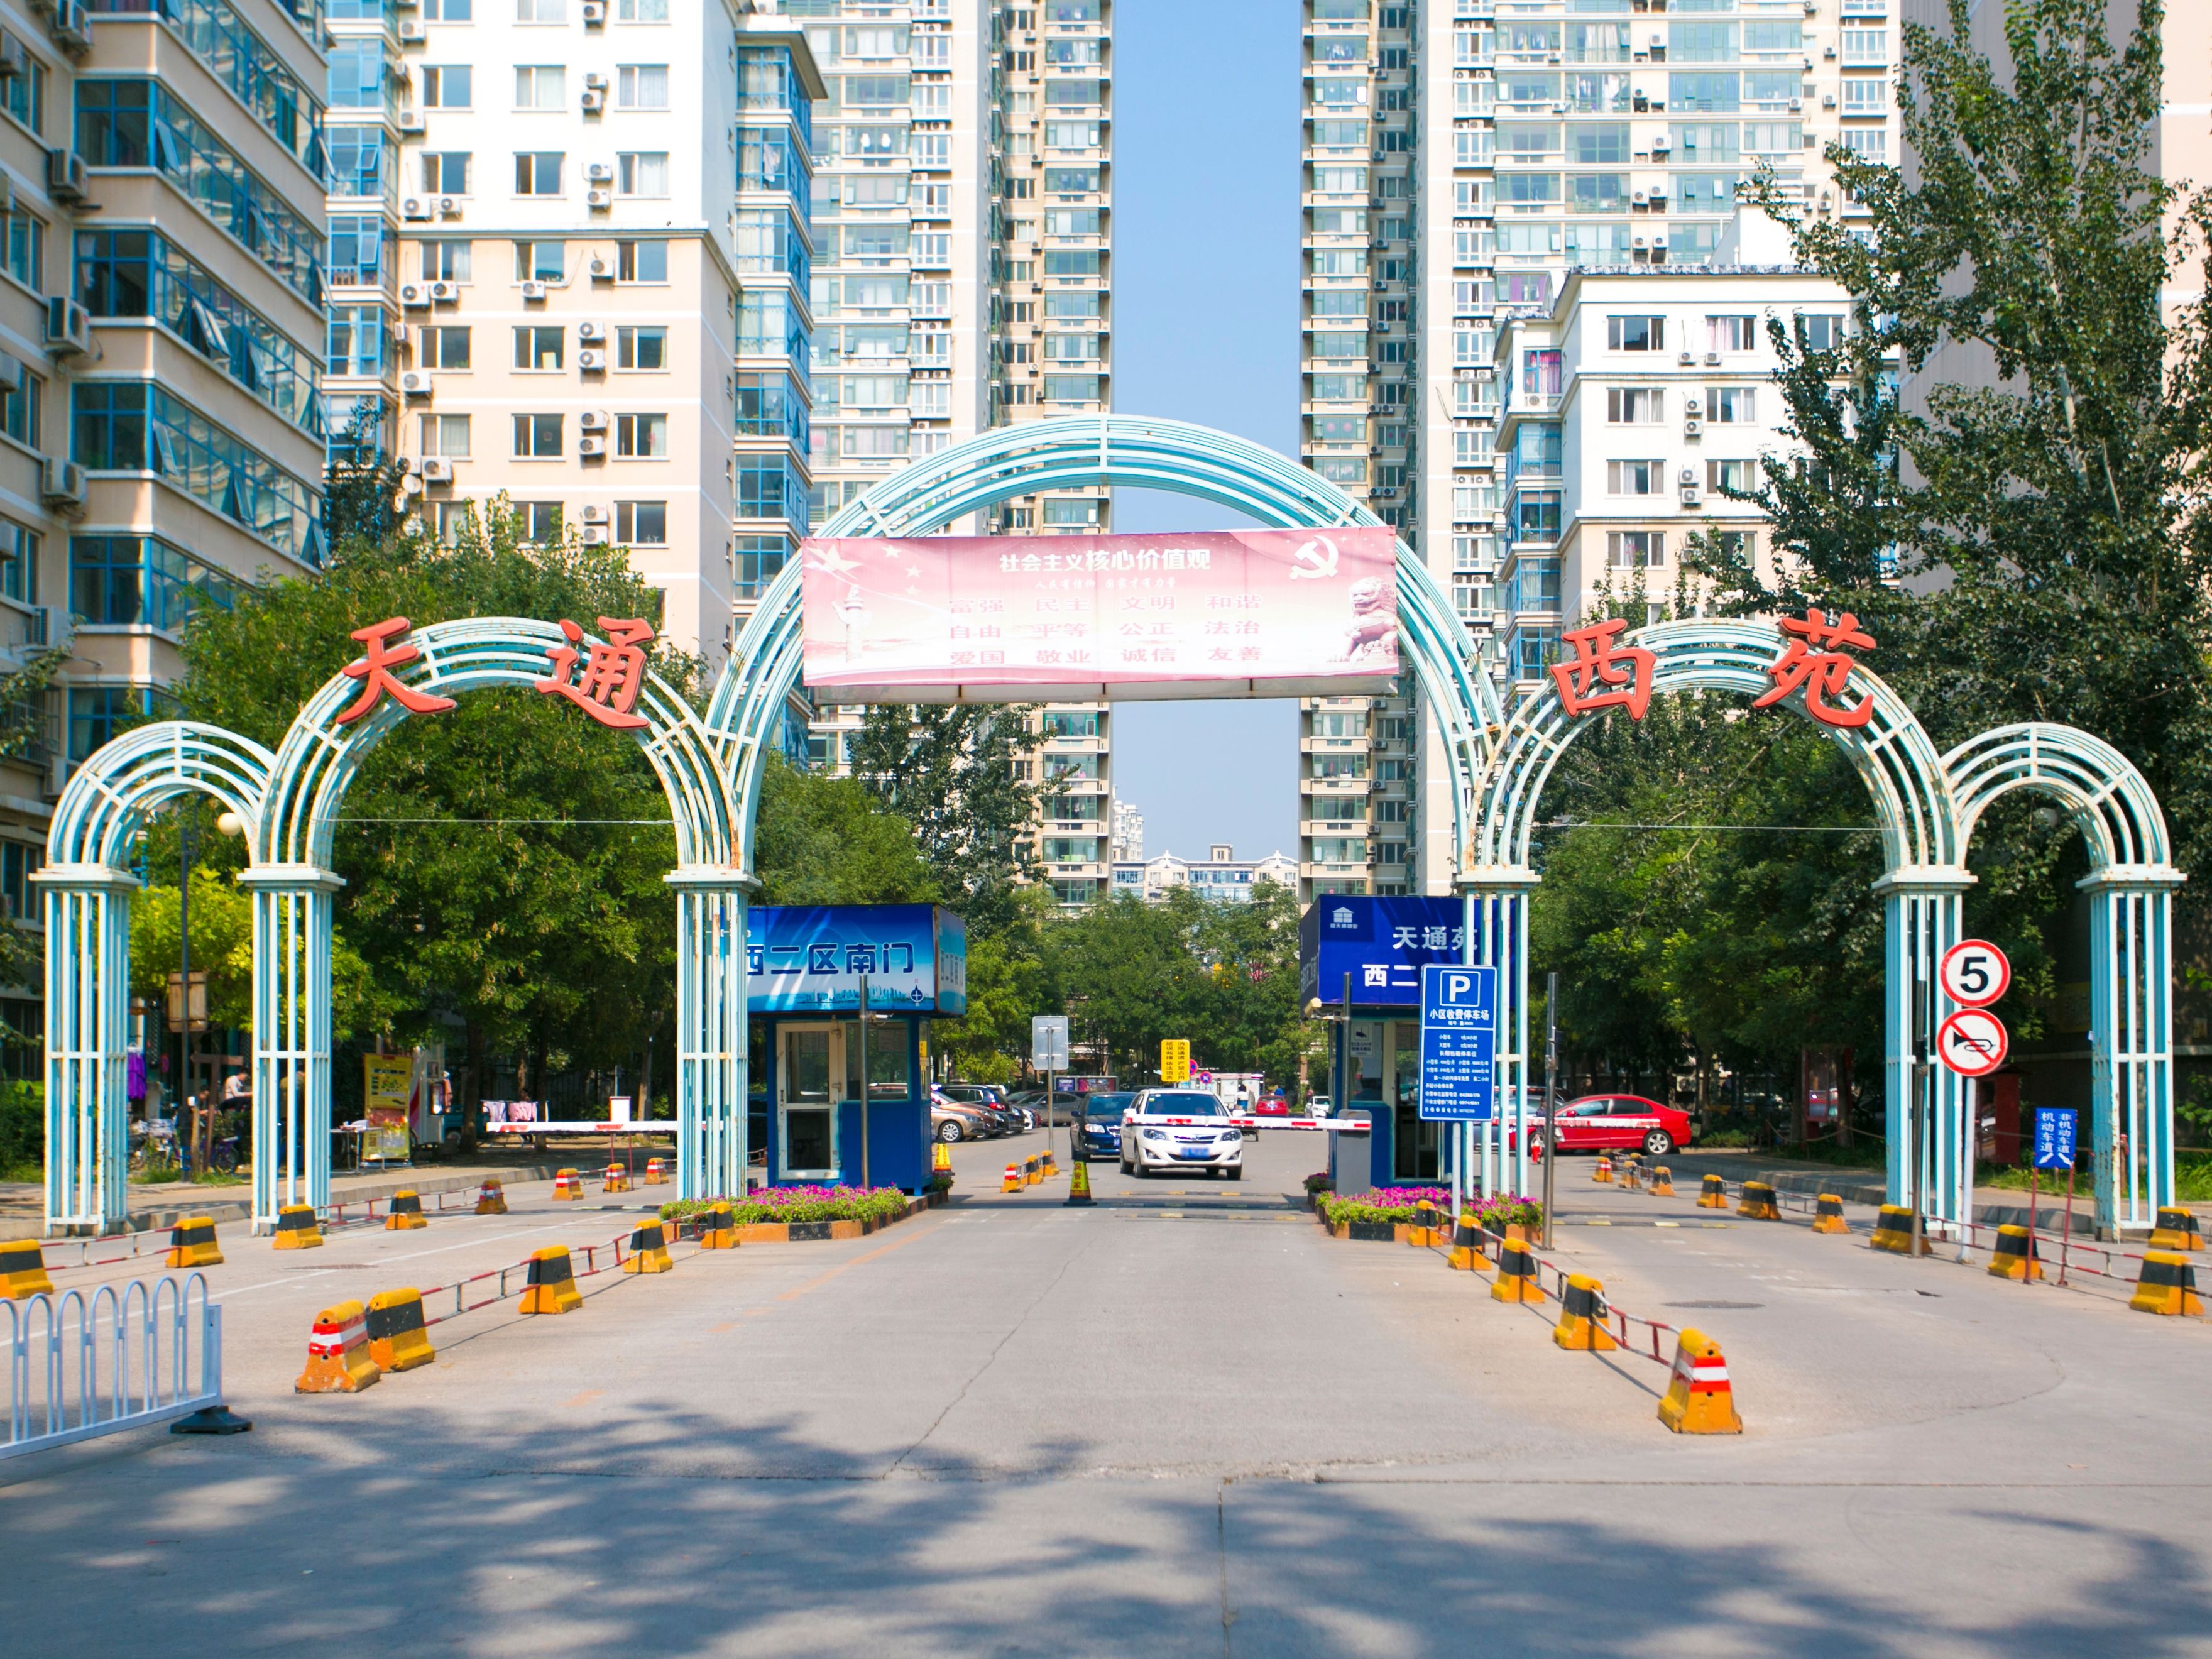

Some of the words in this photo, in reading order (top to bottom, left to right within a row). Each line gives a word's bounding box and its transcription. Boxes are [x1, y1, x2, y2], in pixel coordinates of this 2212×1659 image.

[1000, 549, 1212, 572] 社会主义核心价值观
[949, 598, 1005, 614] 富强
[1035, 597, 1092, 613] 民主
[1120, 595, 1176, 610] 文明
[1205, 593, 1263, 610] 和谐
[950, 624, 1002, 639] 自由
[1032, 622, 1090, 638] 平等
[1119, 621, 1175, 636] 公正
[1204, 620, 1261, 635] 法治
[950, 650, 1005, 665] 爱国
[1036, 649, 1092, 664] 敬业
[1120, 648, 1176, 663] 诚信
[1207, 647, 1264, 662] 友善
[1959, 956, 1989, 994] 5
[1449, 975, 1471, 1002] P
[1430, 1009, 1489, 1021] 小区收费停车场
[2040, 1112, 2056, 1153] 机动车道
[2057, 1113, 2072, 1153] 非机动车道
